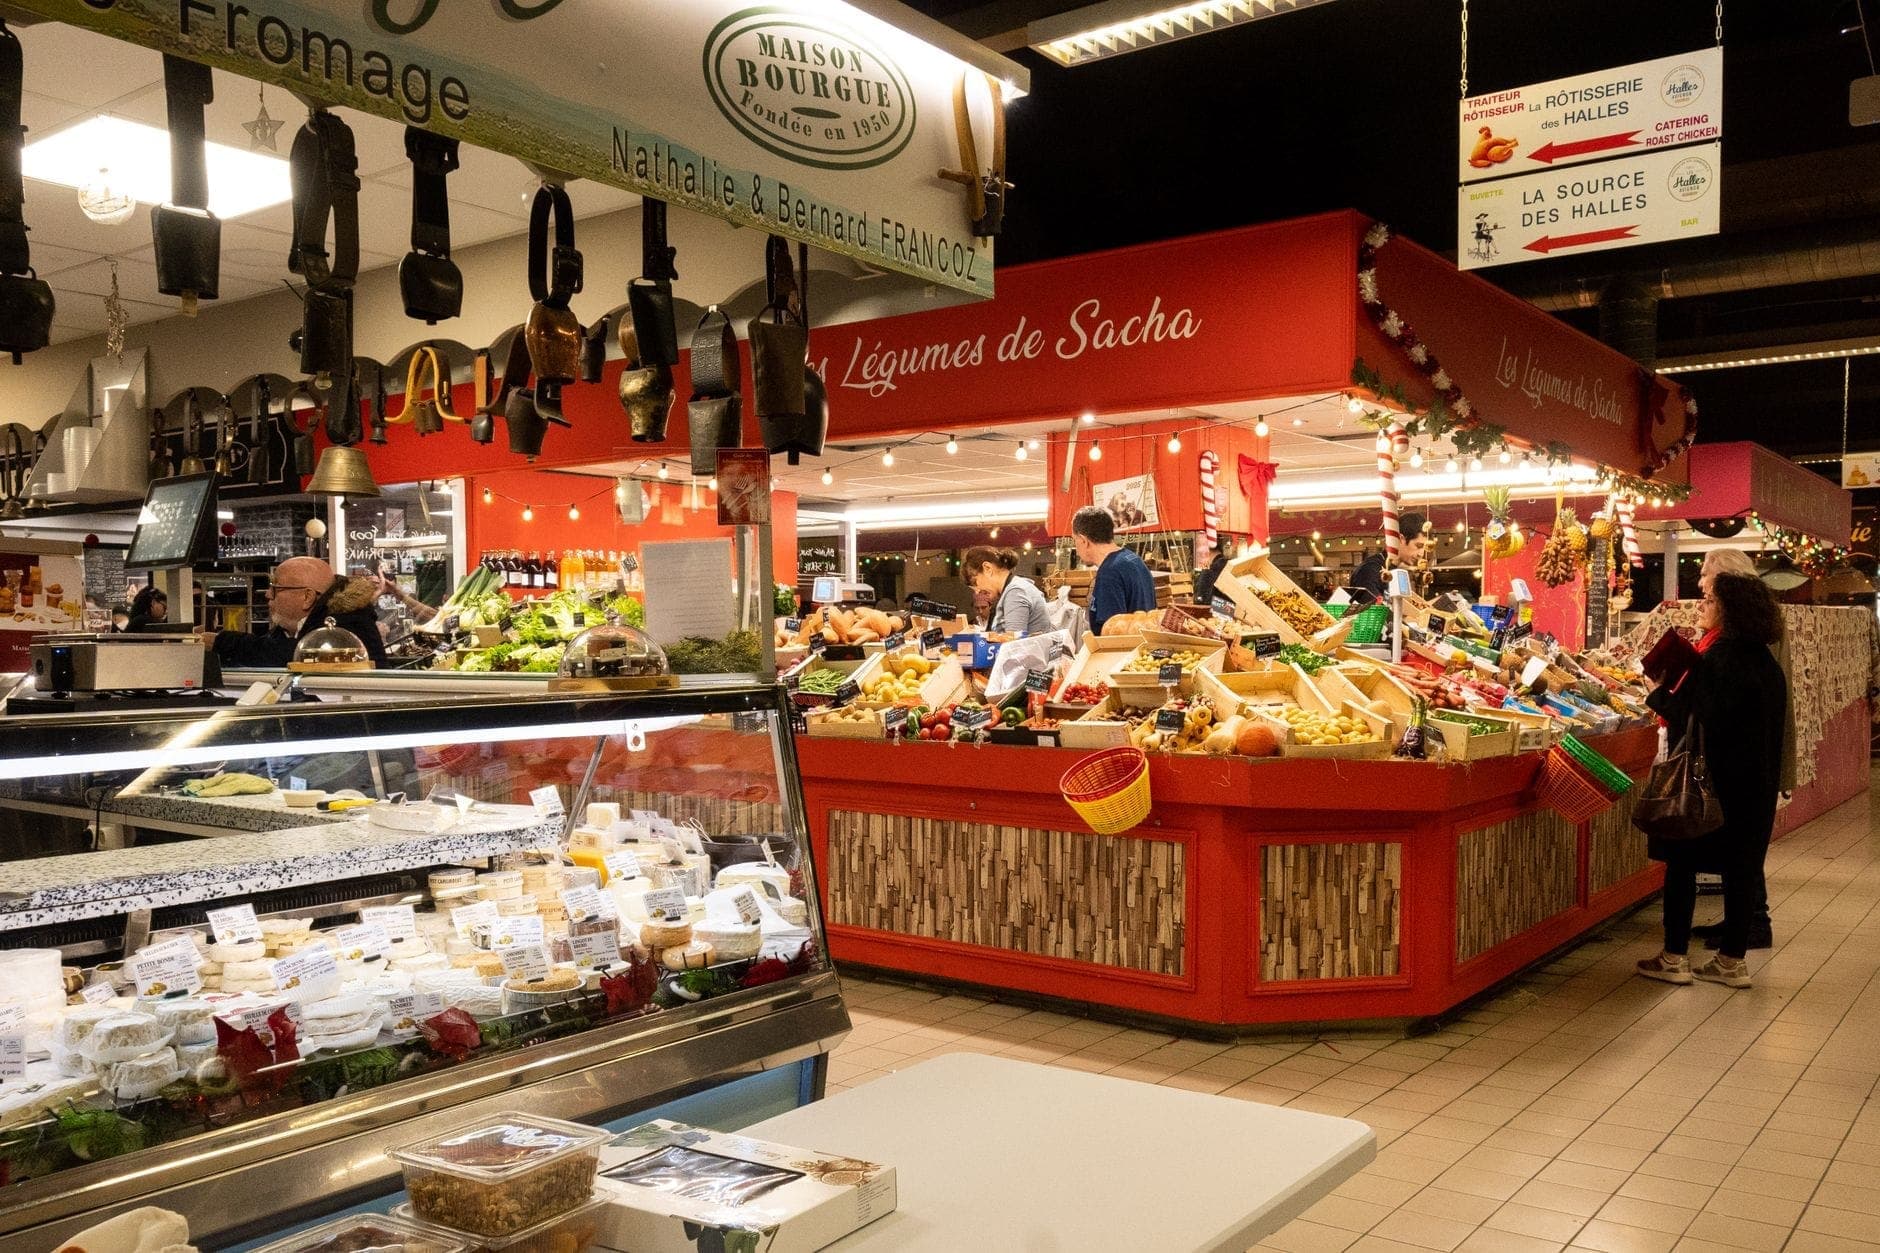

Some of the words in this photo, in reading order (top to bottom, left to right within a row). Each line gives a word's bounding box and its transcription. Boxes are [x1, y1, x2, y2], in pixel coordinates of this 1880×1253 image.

[756, 32, 863, 73] MAISON
[736, 58, 891, 108] BOURGUE
[1466, 91, 1521, 109] TRAITEUR
[1529, 102, 1542, 113] La
[1545, 77, 1644, 108] RÔTISSERIE
[740, 90, 813, 137] Fondée
[825, 127, 846, 141] en
[854, 110, 892, 138] 1950
[1463, 102, 1525, 122] RÔTISSEUR
[1541, 119, 1560, 130] des
[1564, 101, 1630, 125] HALLES
[1655, 114, 1709, 132] CATERING
[1646, 133, 1675, 147] ROAST
[1677, 126, 1719, 143] CHICKEN
[611, 126, 735, 207] Nathalie
[751, 177, 765, 216] &
[777, 183, 868, 248] Bernard
[881, 218, 976, 283] FRANCOZ
[1469, 188, 1505, 201] BUVETTE
[1523, 189, 1545, 205] LA
[1556, 171, 1646, 199] SOURCE
[1522, 207, 1560, 228] DES
[1572, 193, 1647, 220] HALLES
[1681, 217, 1699, 227] BAR
[840, 334, 988, 398] Légumes
[997, 316, 1046, 361] de
[1055, 295, 1203, 360] Sacha
[1496, 335, 1519, 388] Les
[1521, 346, 1572, 409] Légumes
[1574, 375, 1588, 411] de
[1589, 377, 1624, 426] Sacha
